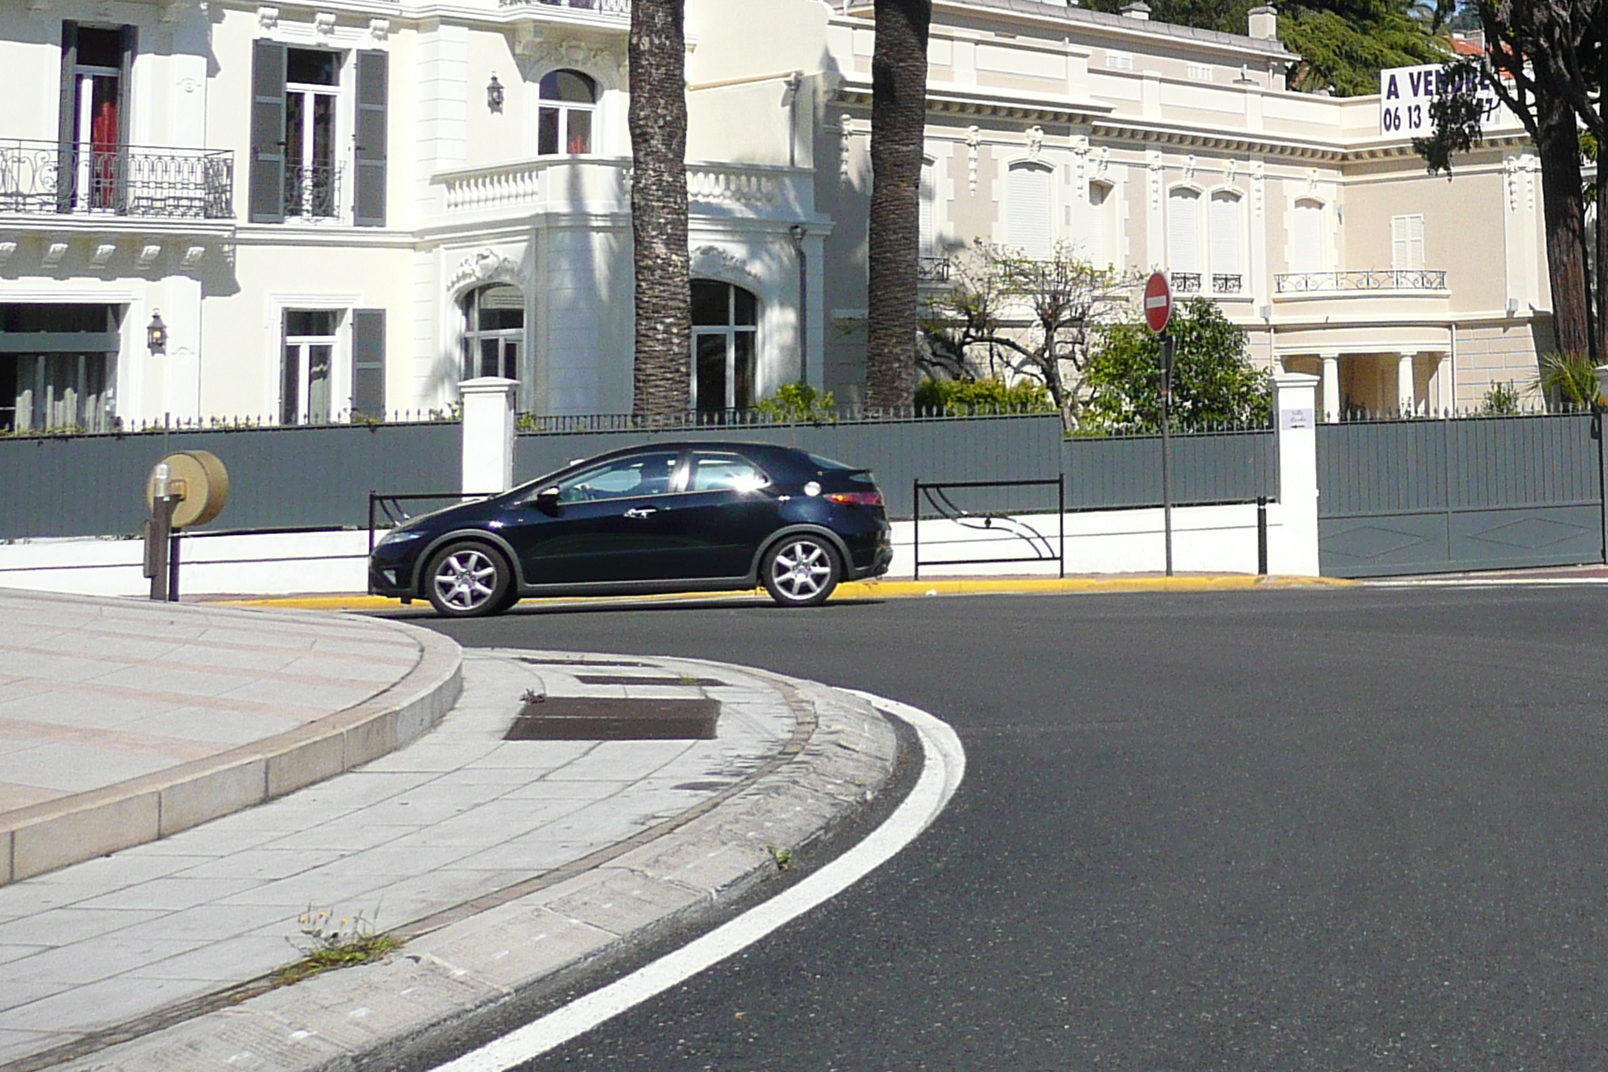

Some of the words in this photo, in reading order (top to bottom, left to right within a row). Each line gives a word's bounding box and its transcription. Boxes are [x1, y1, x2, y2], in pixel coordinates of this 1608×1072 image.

[1386, 74, 1400, 100] A
[1383, 107, 1401, 132] 06
[1407, 104, 1422, 129] 13
